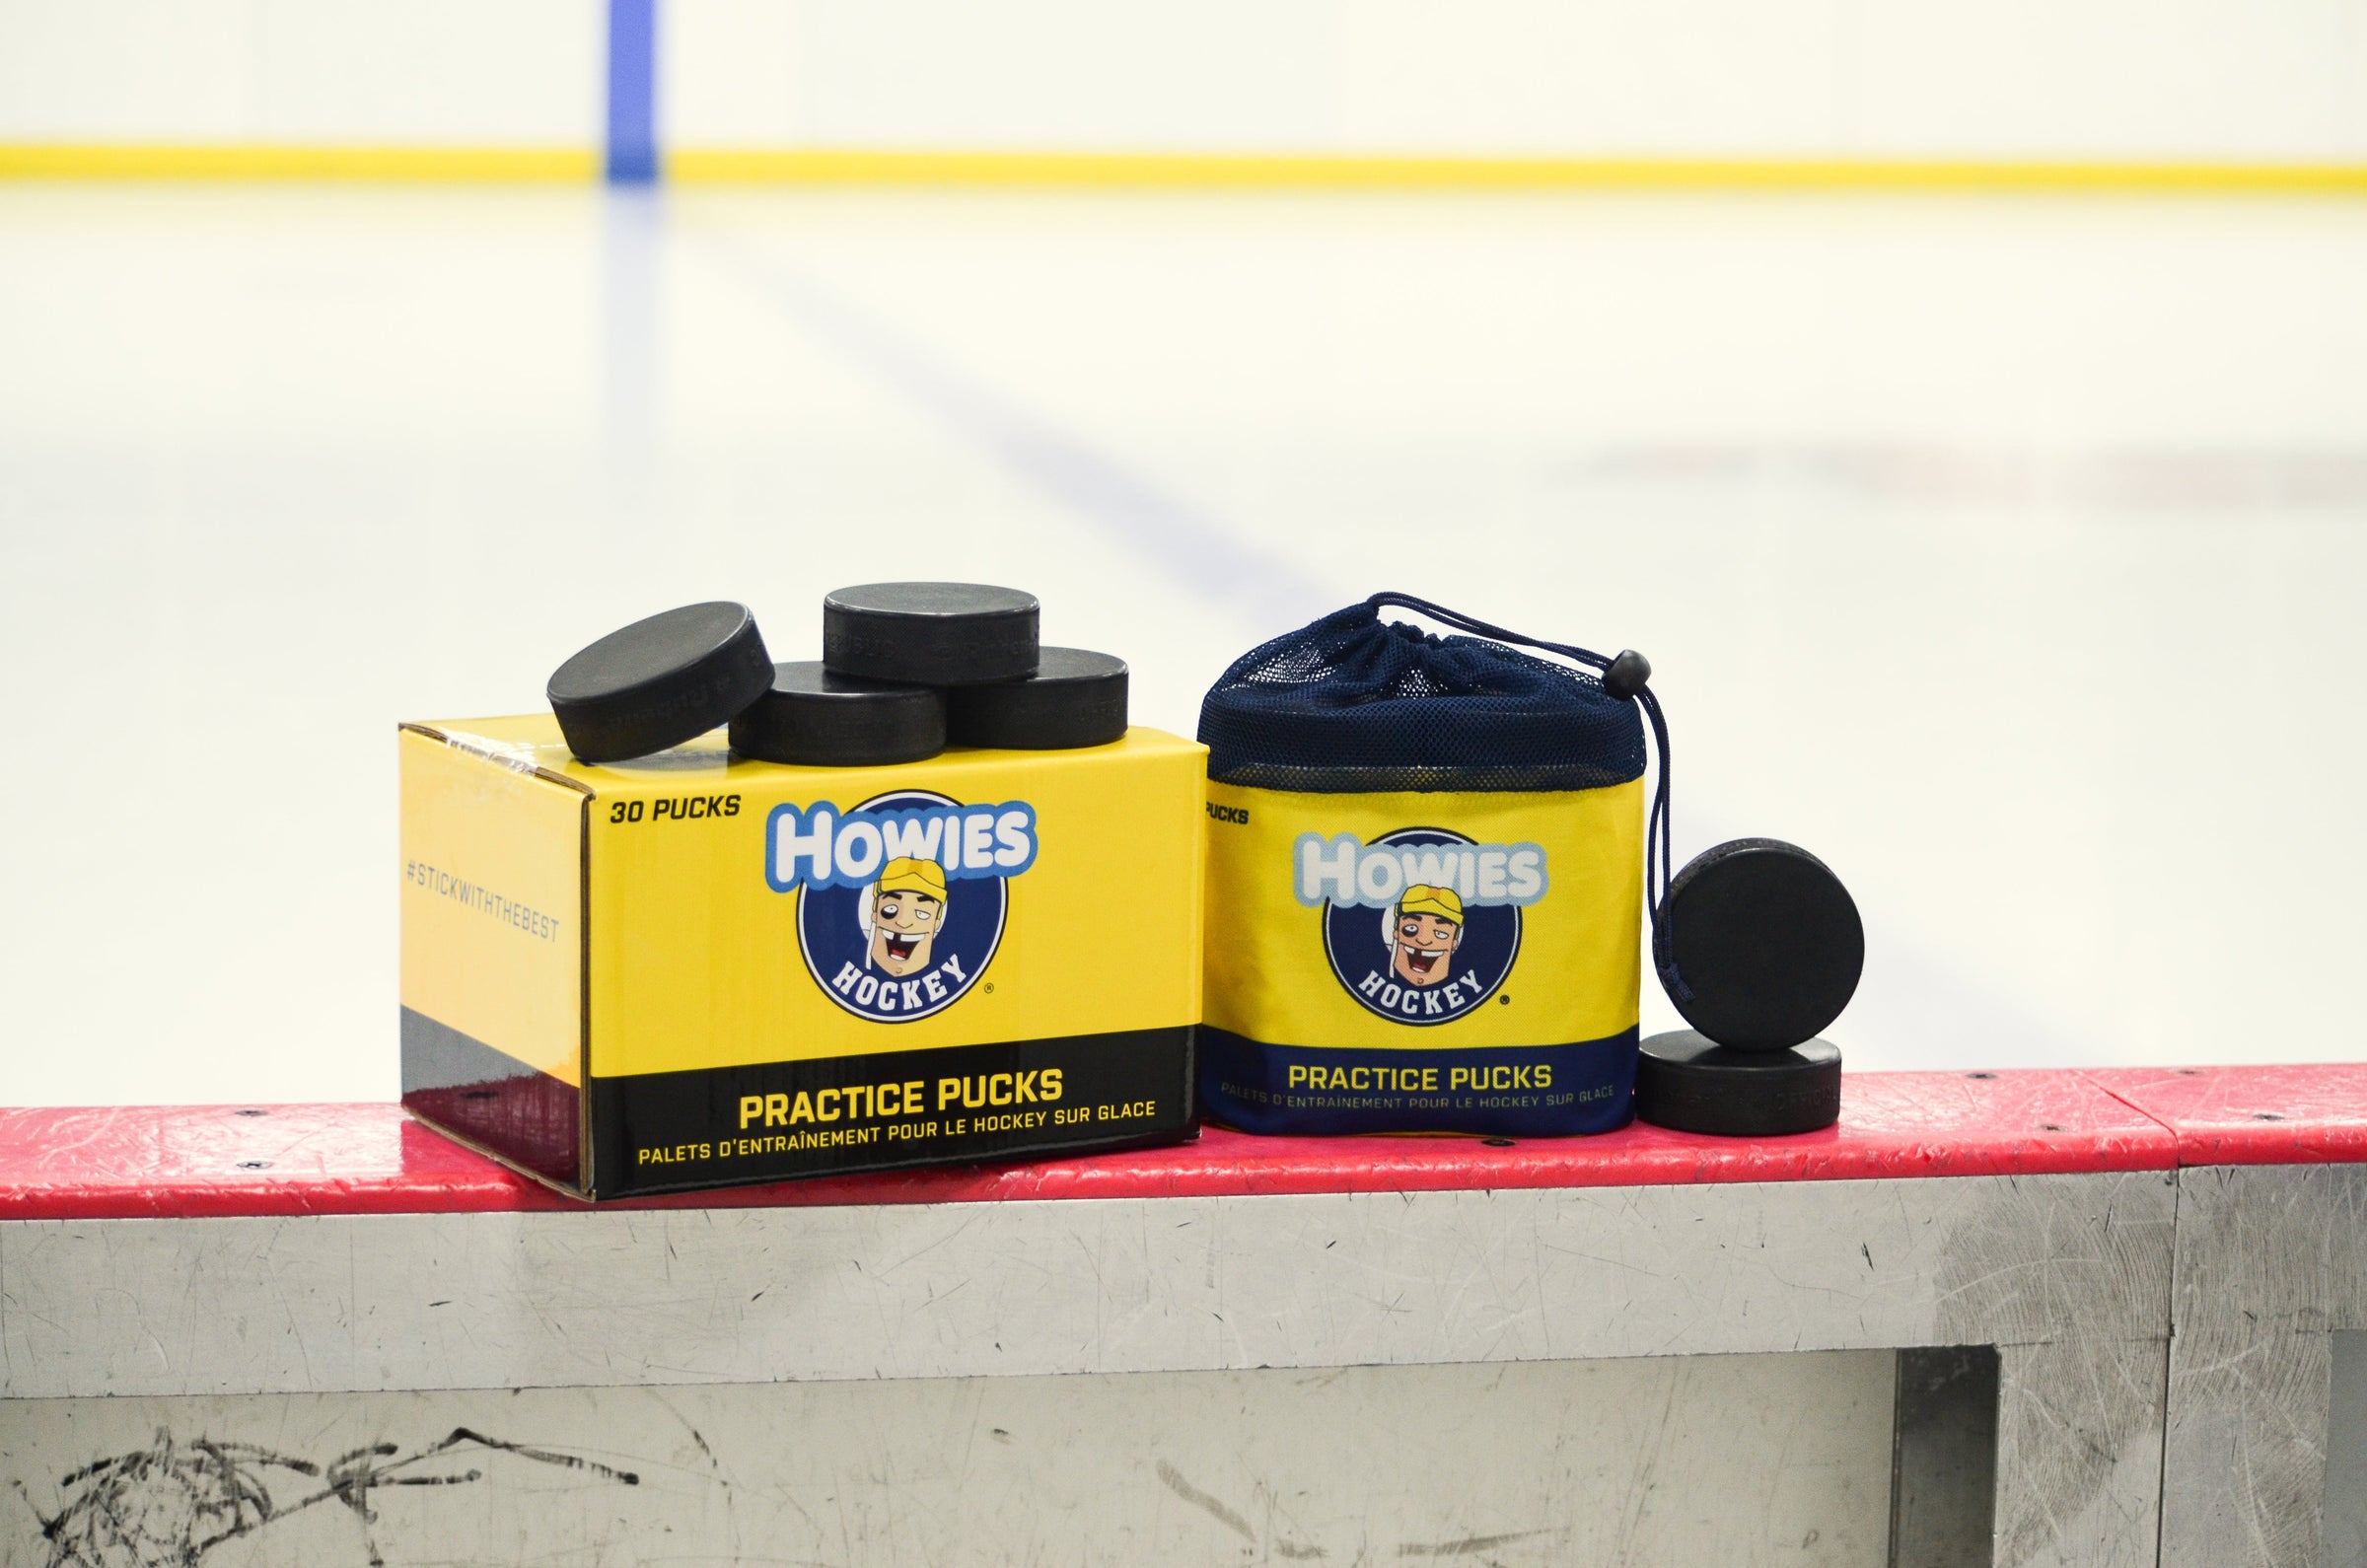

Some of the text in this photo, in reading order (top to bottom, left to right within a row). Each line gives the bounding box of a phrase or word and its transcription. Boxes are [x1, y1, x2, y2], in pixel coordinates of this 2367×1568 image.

[610, 795, 741, 823] 30 PUCKS
[773, 808, 1034, 886] HOWIES
[1300, 837, 1544, 902] HOWIES
[406, 860, 559, 943] #STICKWITHTHEBEST
[832, 954, 968, 1010] HOCKEY
[1357, 969, 1484, 1015] HOCKEY
[739, 1068, 1064, 1129] PRACTICE PUCKS
[1221, 1082, 1268, 1104] PALETS
[1408, 1098, 1450, 1108] POUR
[1456, 1097, 1473, 1108] LE
[1479, 1097, 1540, 1108] HOCKEY
[1545, 1093, 1574, 1105] SUR
[1579, 1085, 1614, 1103] GLACE
[1288, 1065, 1552, 1091] PRACTICE PUCKS
[638, 1100, 1156, 1166] PALETS D'ENTRAÎNEMENT POUR LE HOCKEY SUR GLACE
